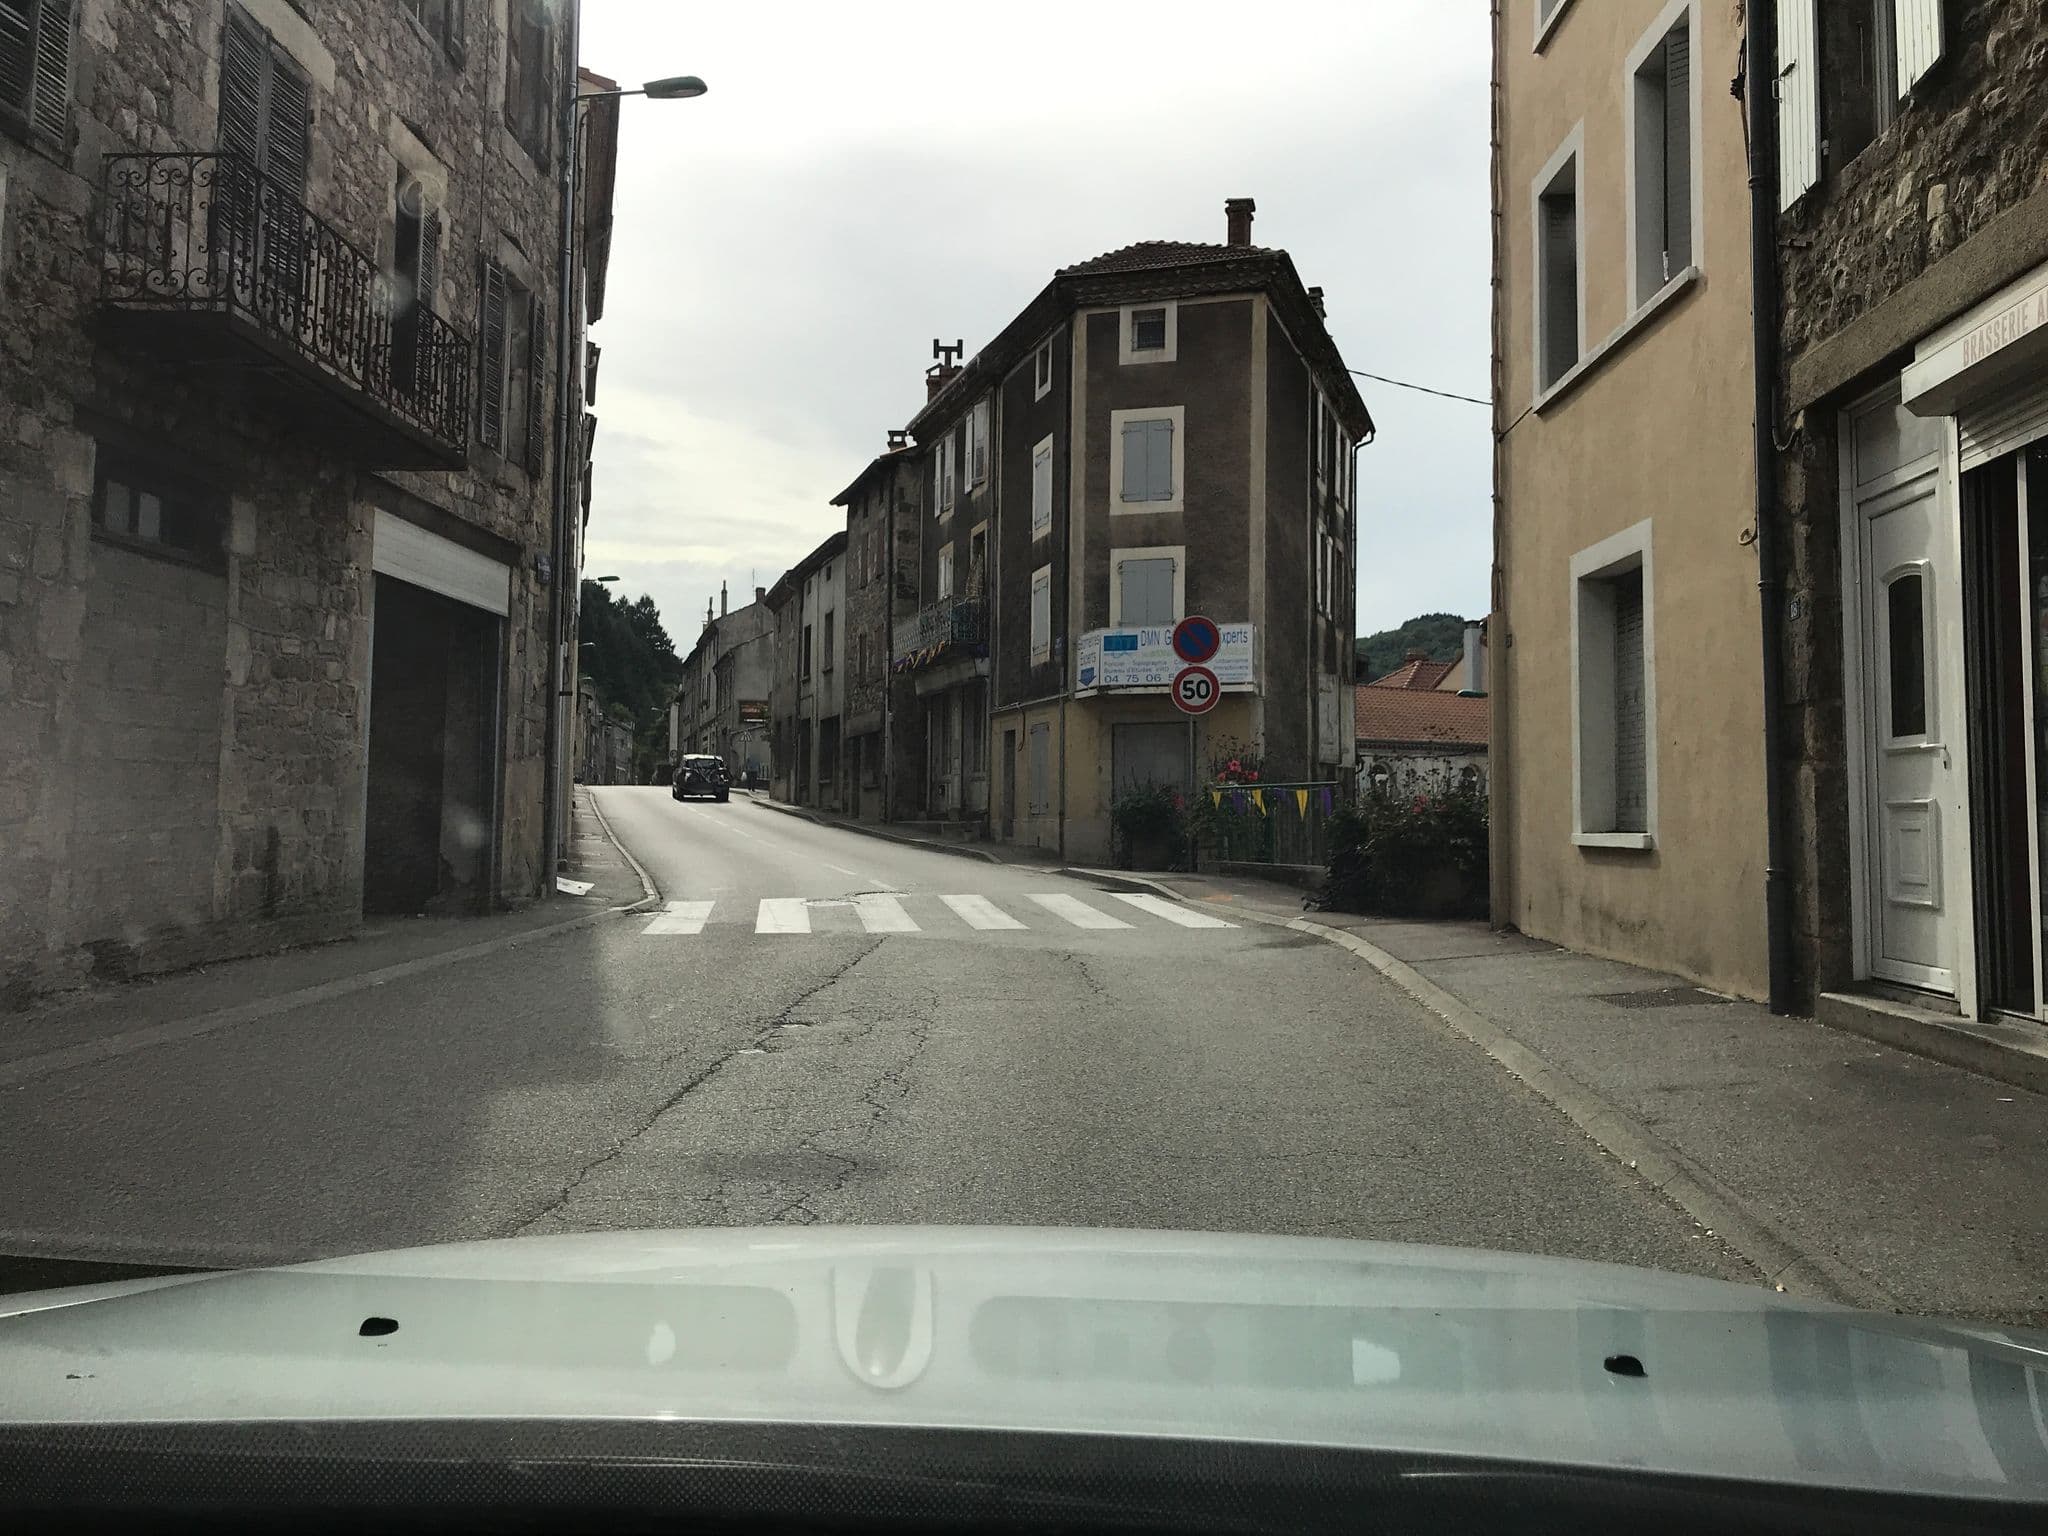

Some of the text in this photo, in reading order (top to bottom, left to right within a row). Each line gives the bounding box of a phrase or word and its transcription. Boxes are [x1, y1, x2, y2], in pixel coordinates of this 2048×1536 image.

[1962, 301, 2029, 368] BRASSERIE
[1140, 629, 1160, 646] DMN
[1221, 628, 1248, 647] xperts
[1104, 674, 1119, 683] 04
[1126, 674, 1140, 683] 75
[1145, 673, 1162, 682] 06
[1182, 680, 1210, 700] 50
